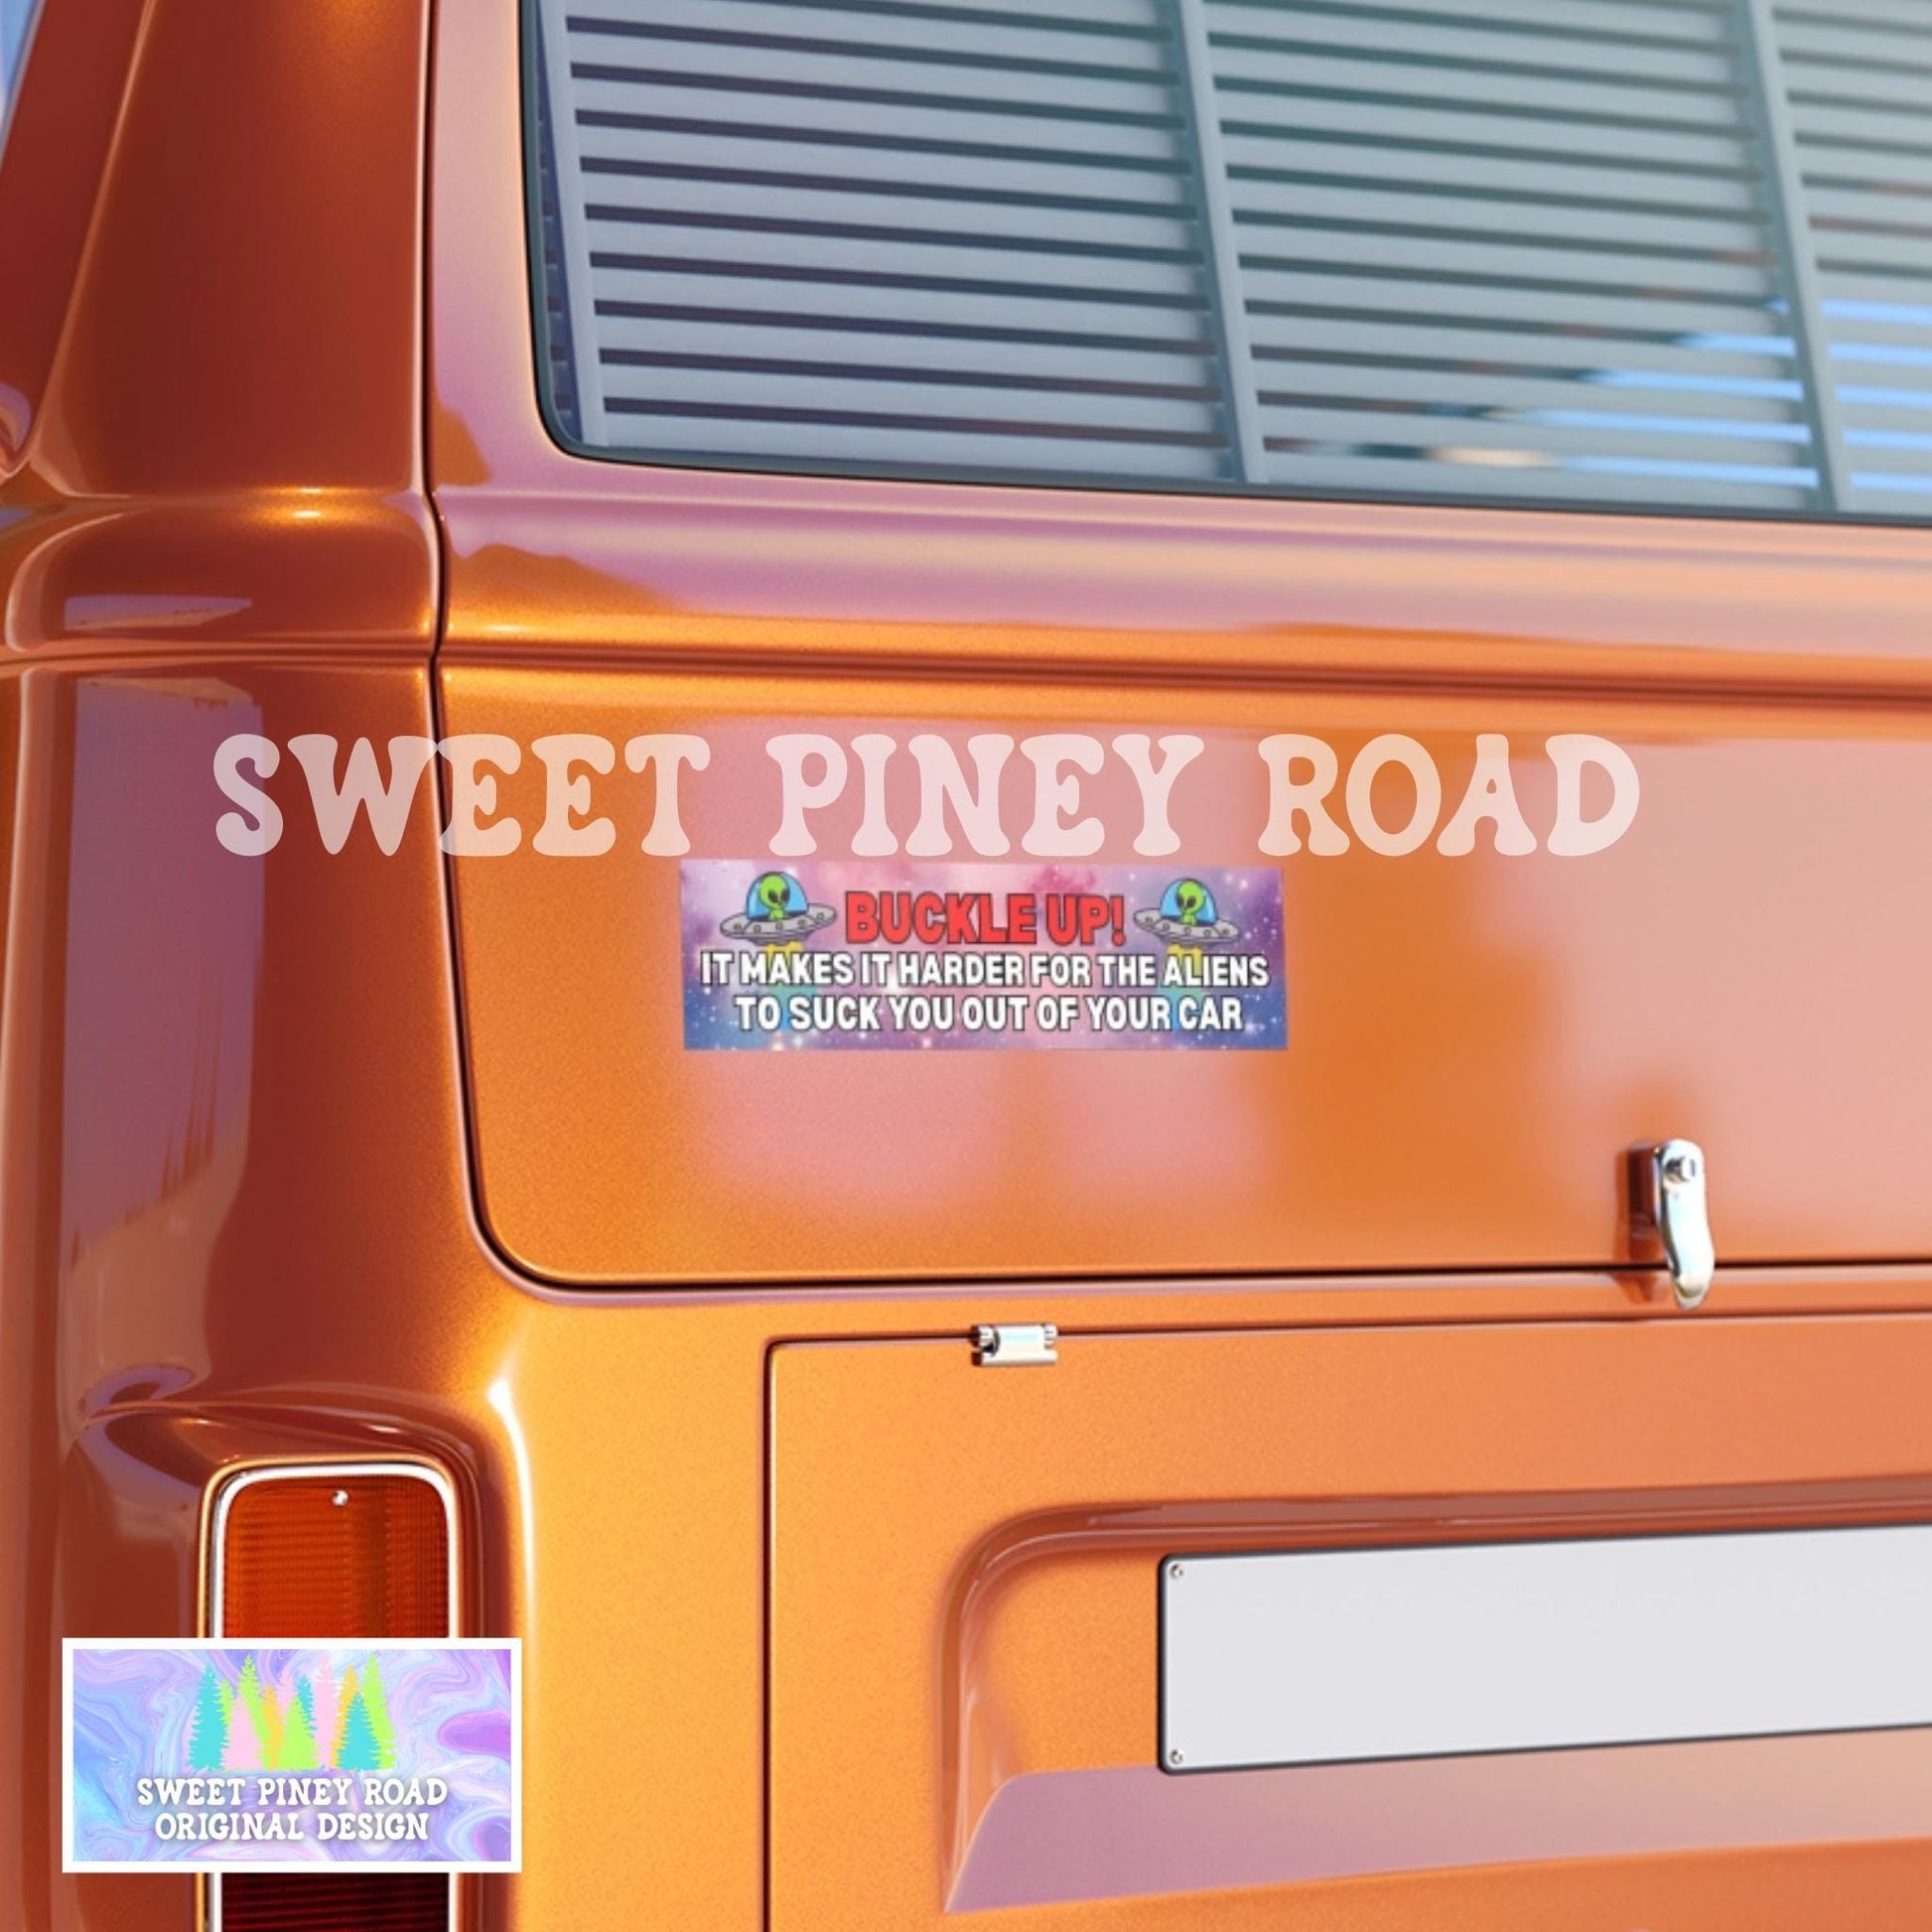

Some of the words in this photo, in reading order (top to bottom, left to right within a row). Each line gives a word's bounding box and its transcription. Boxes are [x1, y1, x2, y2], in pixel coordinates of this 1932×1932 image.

[845, 892, 1037, 945] BUCKLE
[1045, 894, 1127, 946] UP!
[700, 951, 734, 986] IT
[741, 951, 854, 987] MAKES
[860, 951, 893, 987] IT
[897, 952, 1029, 987] HARDER
[1031, 953, 1092, 987] FOR
[1096, 954, 1158, 988] THE
[1164, 955, 1269, 988] ALIENS
[734, 995, 781, 1032] TO
[788, 995, 881, 1032] SUCK
[887, 995, 957, 1032] YOU
[961, 995, 1031, 1032] OUT
[1036, 996, 1079, 1032] OF
[1085, 996, 1172, 1032] YOUR
[1177, 996, 1243, 1033] CAR
